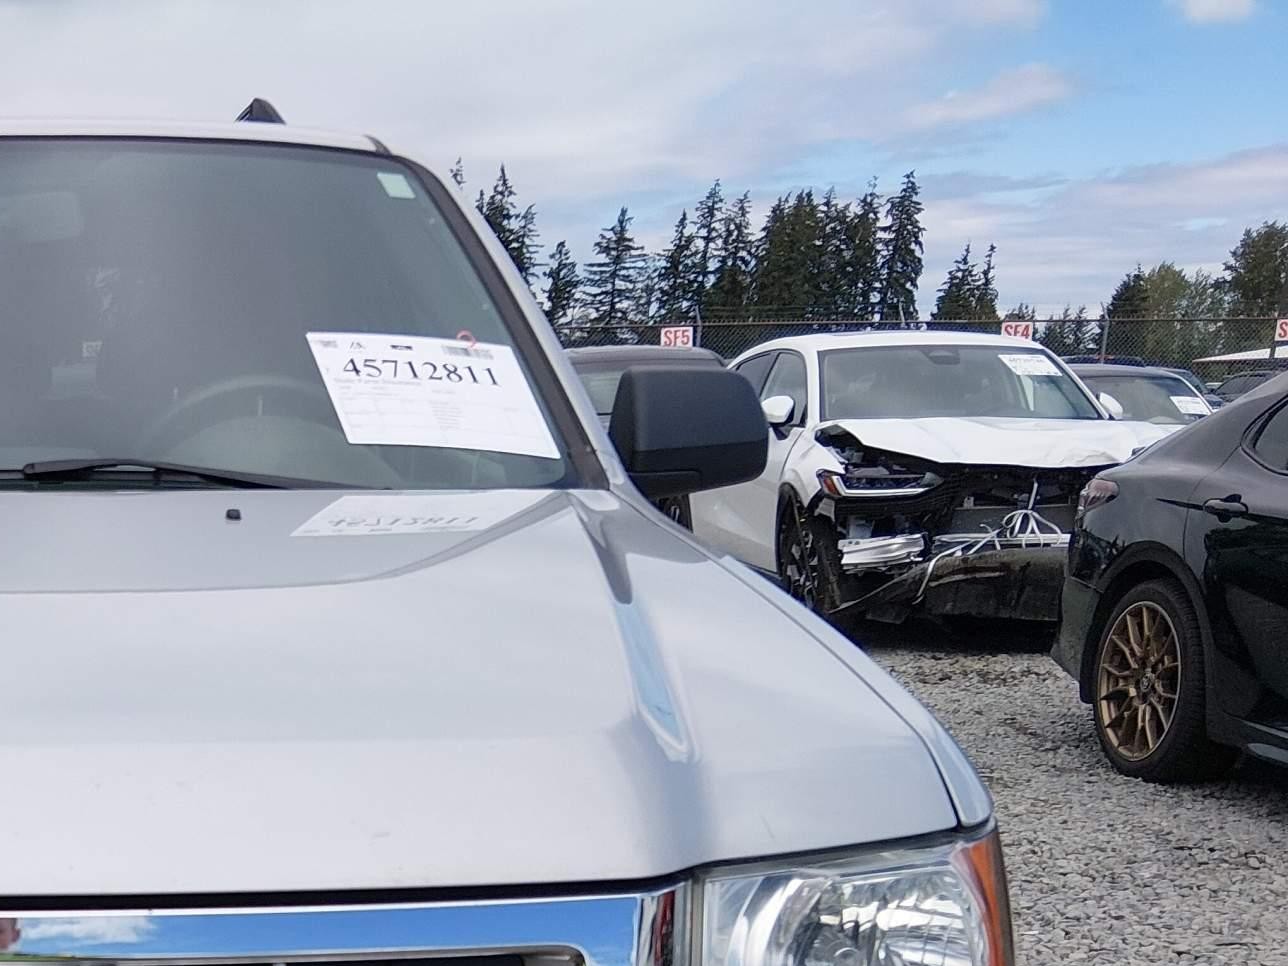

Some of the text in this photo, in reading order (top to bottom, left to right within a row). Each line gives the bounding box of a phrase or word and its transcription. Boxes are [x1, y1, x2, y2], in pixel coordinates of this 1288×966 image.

[664, 329, 690, 347] SF5
[1004, 324, 1030, 339] SF4
[343, 357, 500, 387] 45712811
